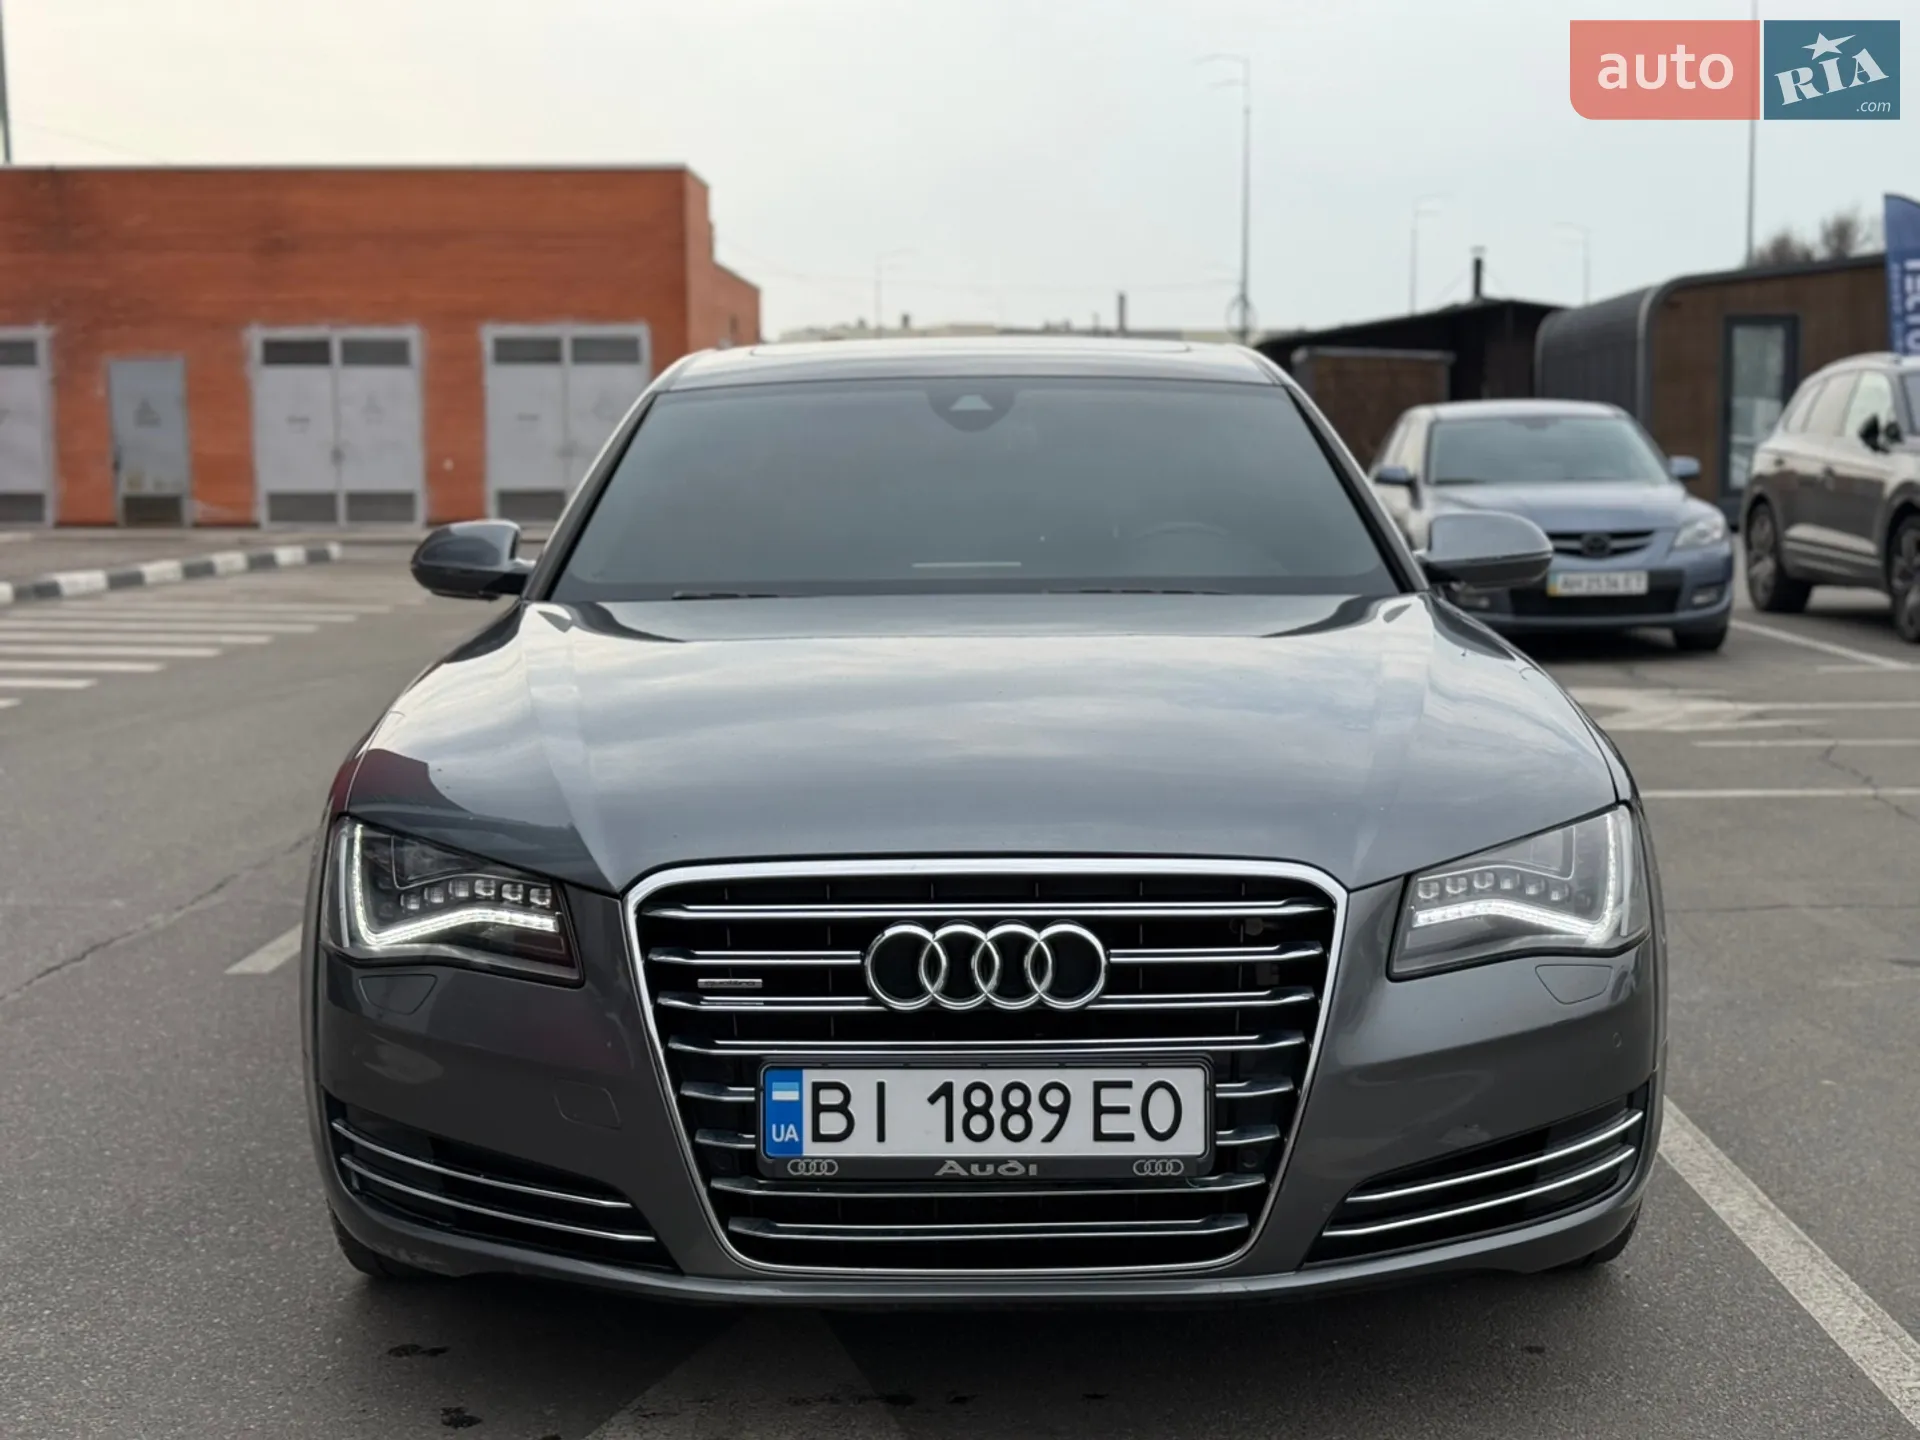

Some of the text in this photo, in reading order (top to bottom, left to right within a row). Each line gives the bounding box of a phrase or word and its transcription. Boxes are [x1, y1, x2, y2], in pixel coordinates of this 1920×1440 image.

[811, 1080, 1184, 1144] BI 1889 EO
[771, 1123, 799, 1143] UA
[934, 1160, 1038, 1177] Audi
